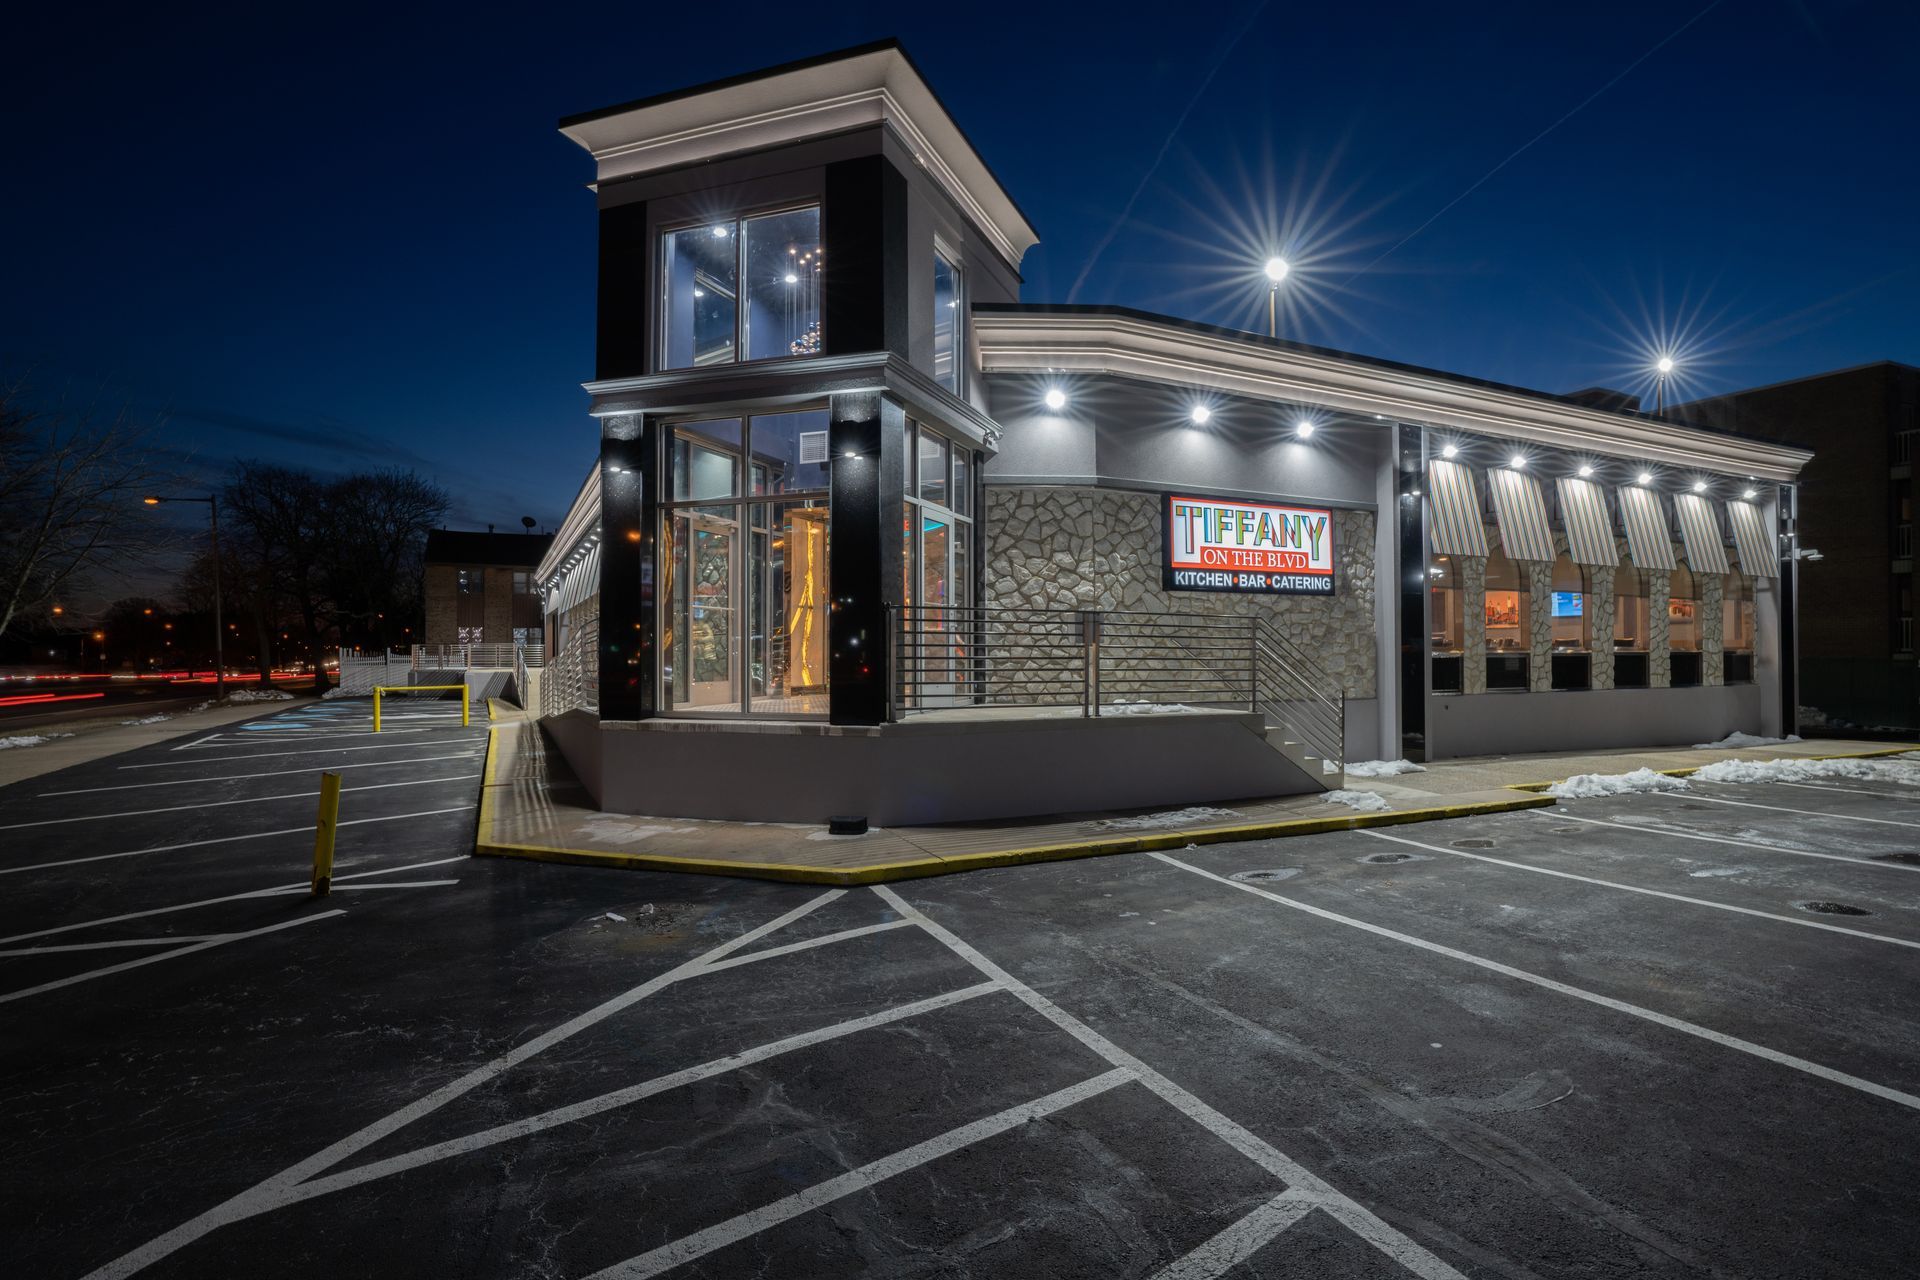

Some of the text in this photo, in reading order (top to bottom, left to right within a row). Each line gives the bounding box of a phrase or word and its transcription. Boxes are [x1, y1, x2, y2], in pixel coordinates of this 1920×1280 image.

[1176, 505, 1327, 560] TIFFANY
[1203, 549, 1306, 568] ON THE BLVD
[1175, 572, 1331, 590] KITCHEN BAR CATERING
